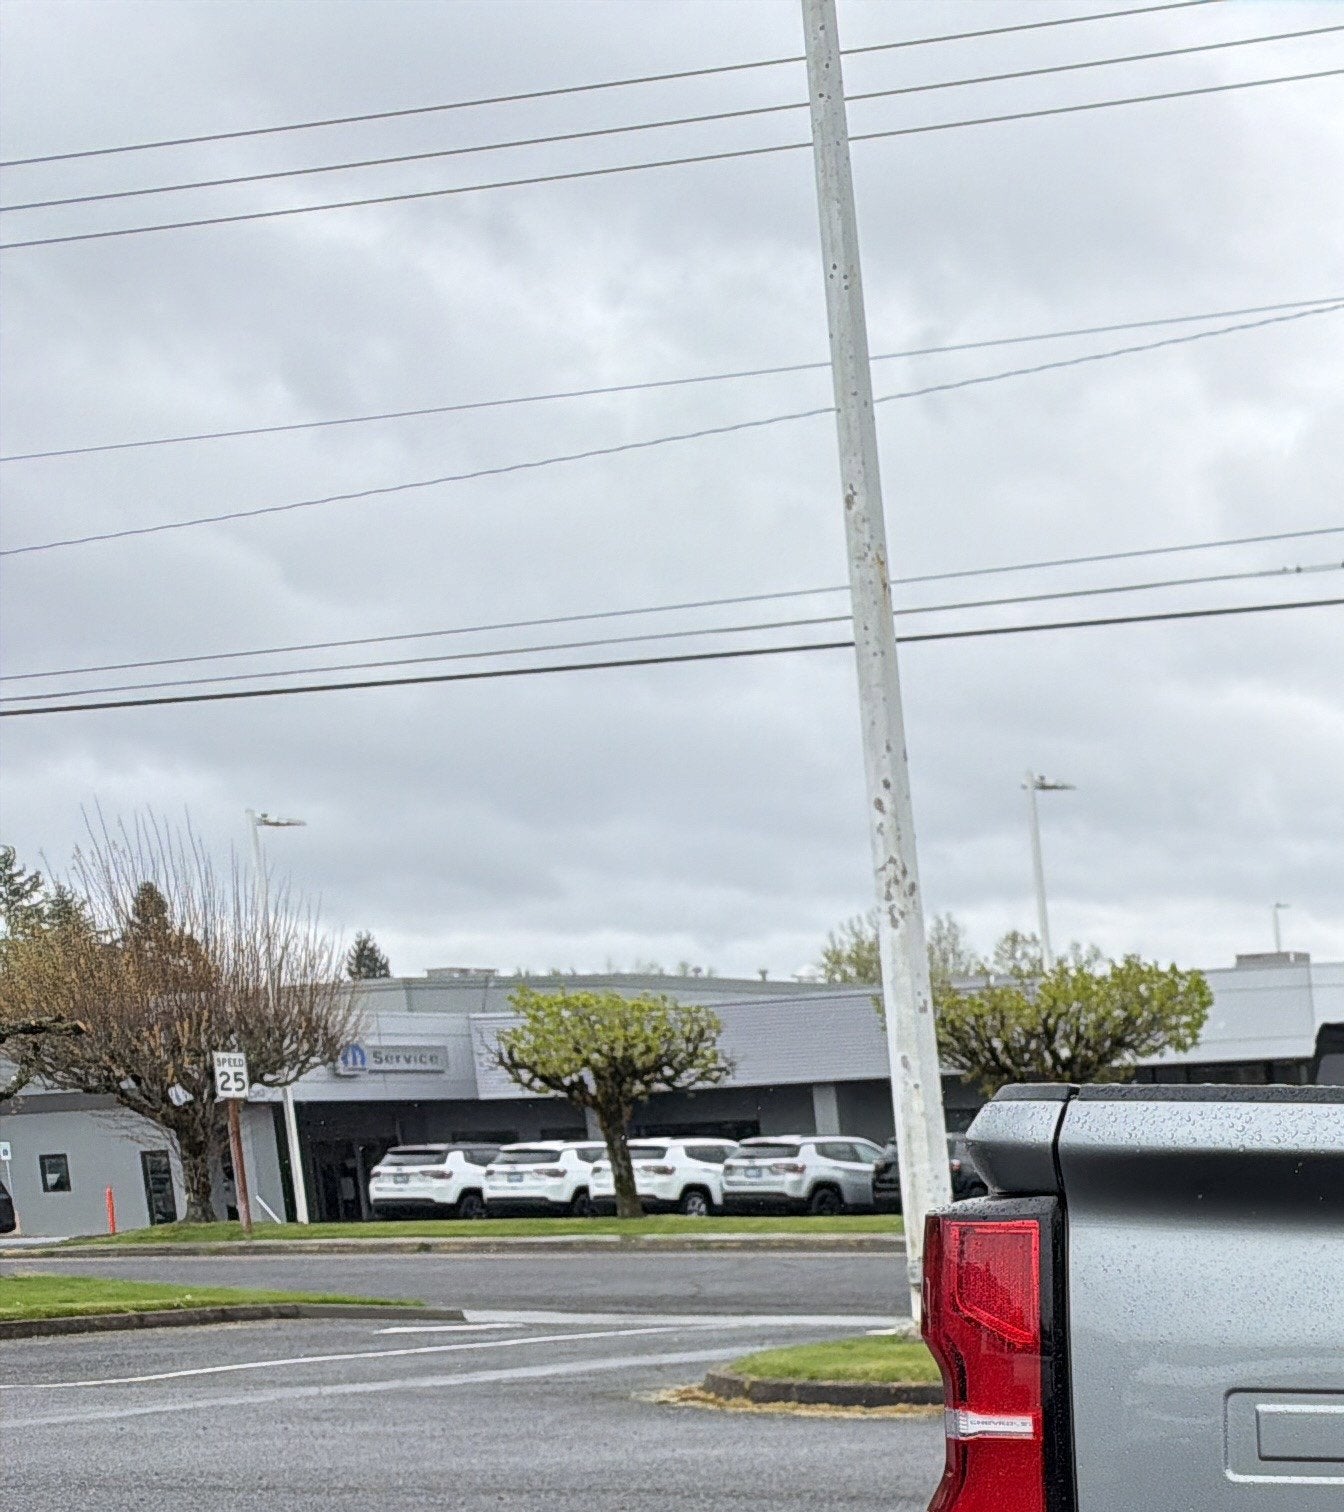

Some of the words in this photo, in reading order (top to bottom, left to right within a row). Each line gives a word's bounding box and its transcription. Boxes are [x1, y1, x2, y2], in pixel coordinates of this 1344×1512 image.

[216, 1057, 244, 1067] SPEED
[373, 1050, 439, 1065] Service
[219, 1070, 246, 1092] 25
